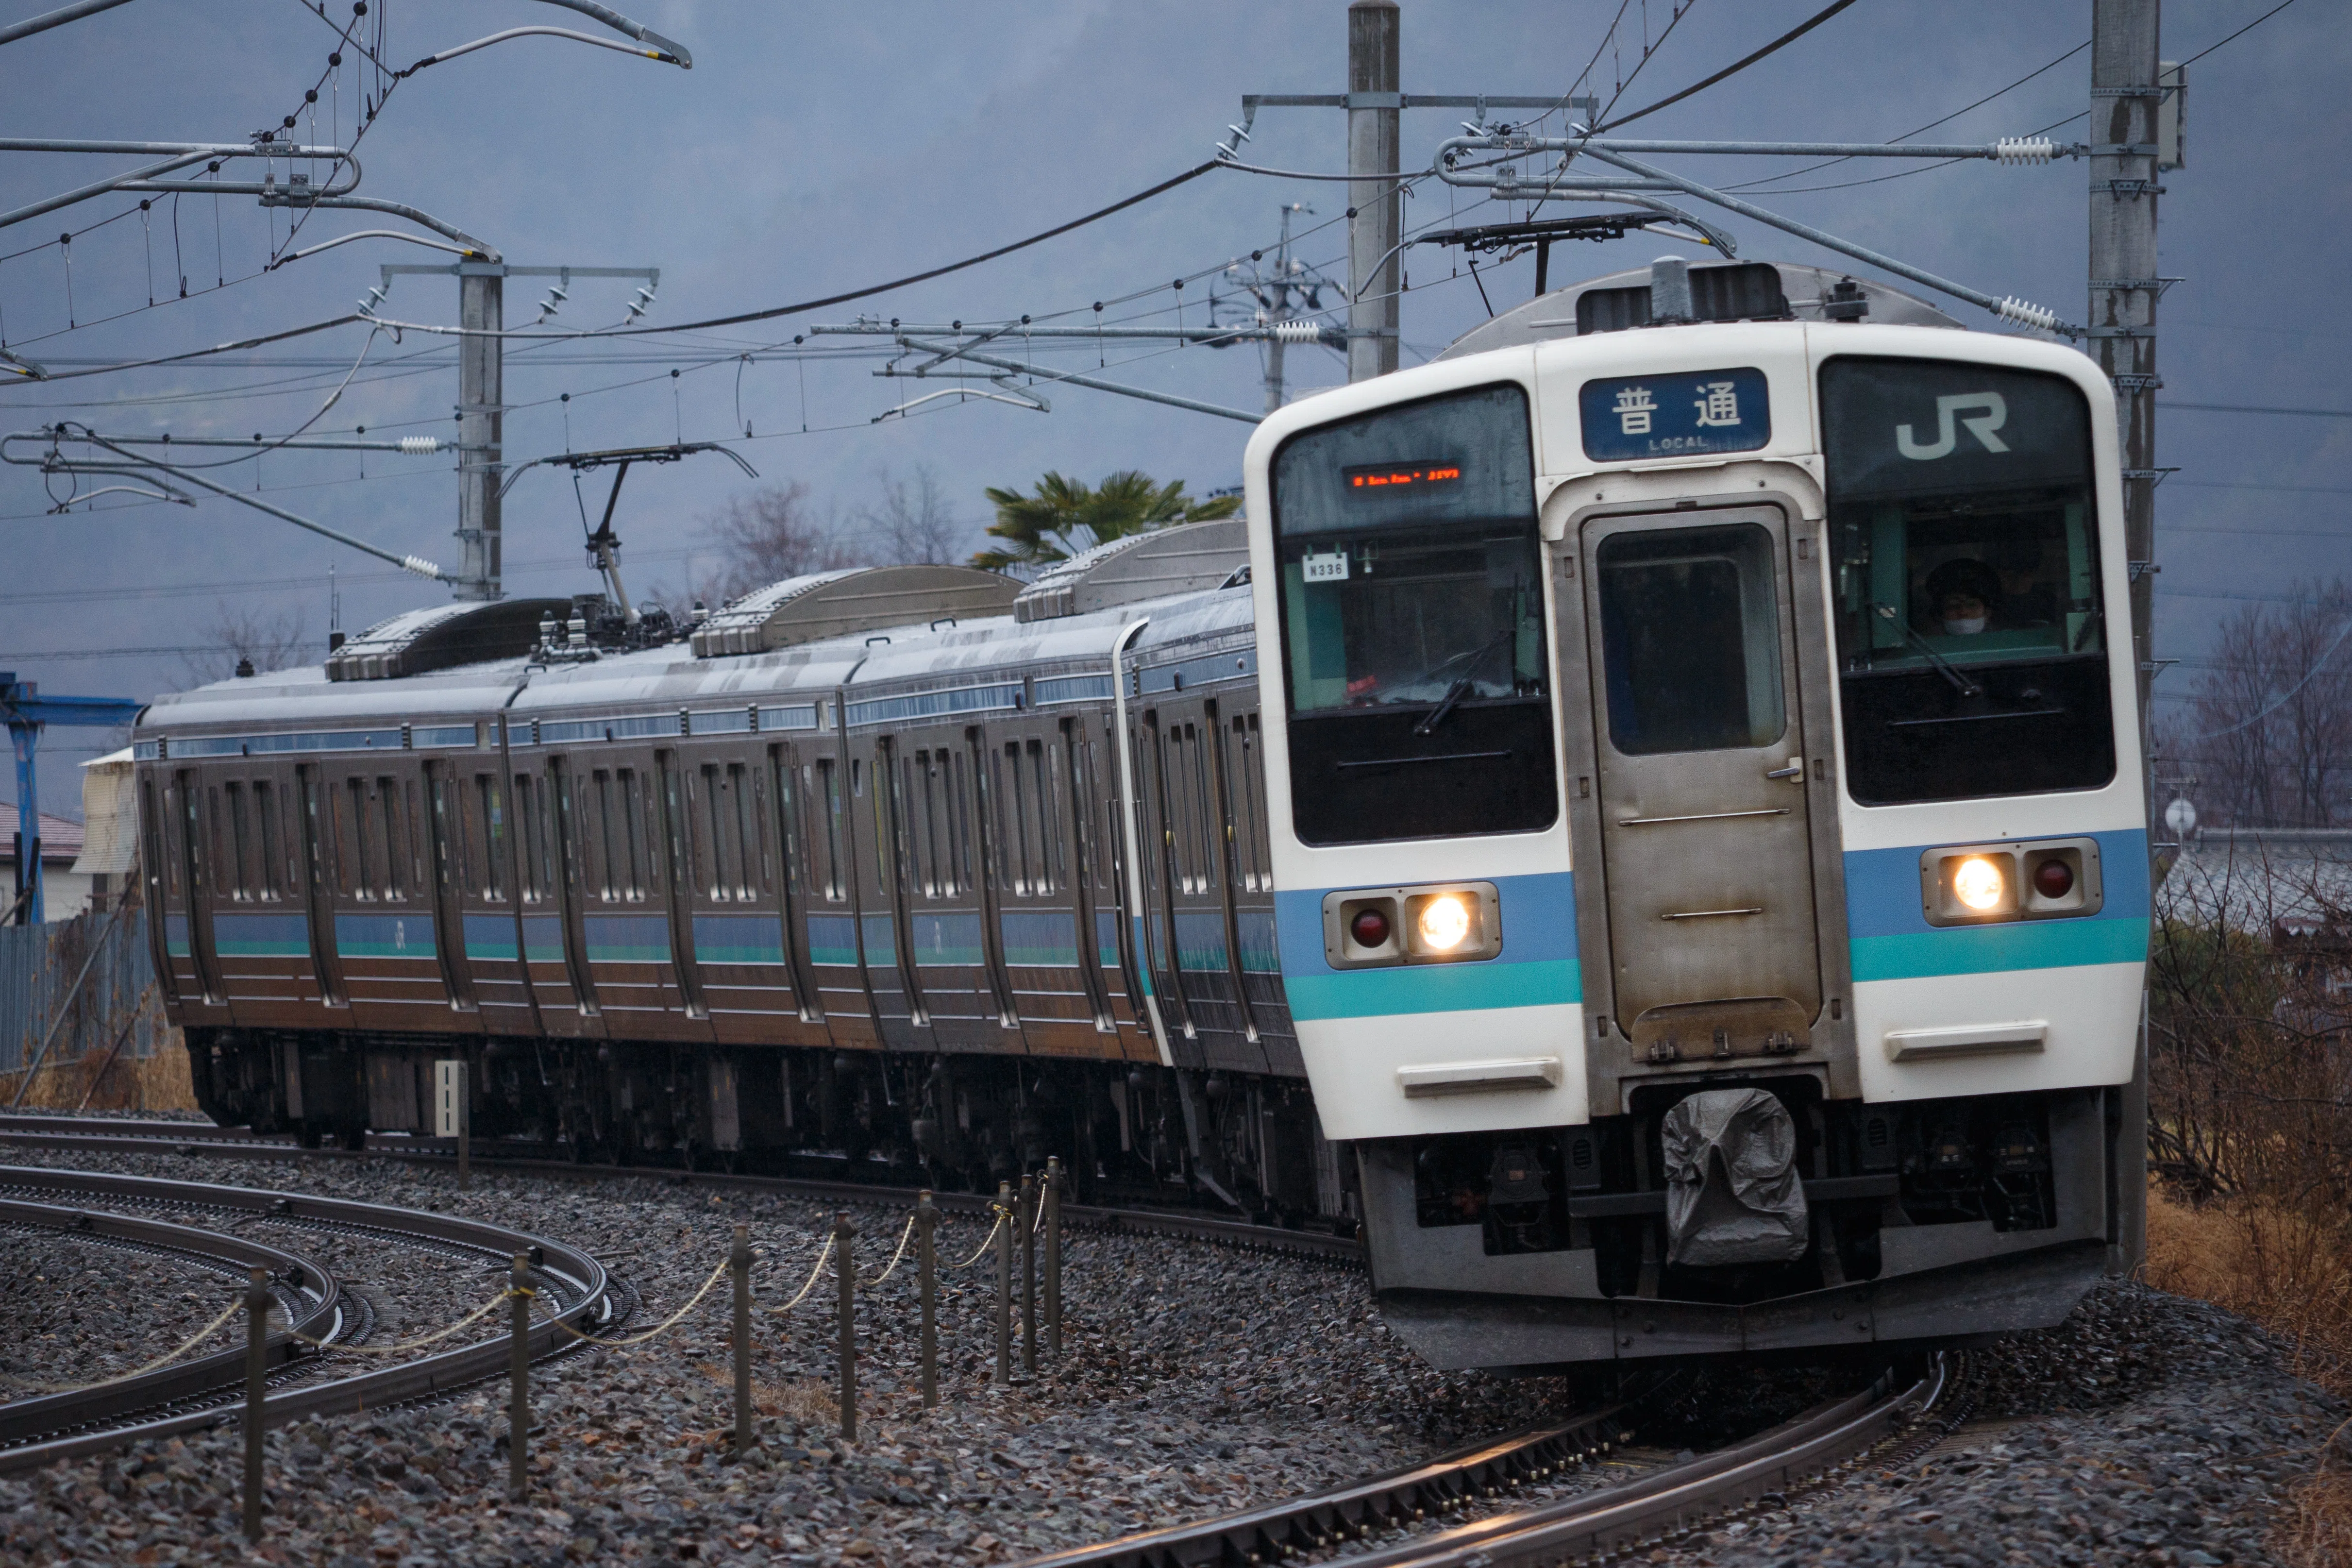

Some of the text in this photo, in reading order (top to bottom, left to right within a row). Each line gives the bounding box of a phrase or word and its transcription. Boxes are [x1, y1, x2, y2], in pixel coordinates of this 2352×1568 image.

[1612, 381, 1741, 435] 普通
[1896, 391, 2012, 460] JR
[1648, 436, 1707, 452] LOCAL
[1310, 563, 1342, 576] N336
